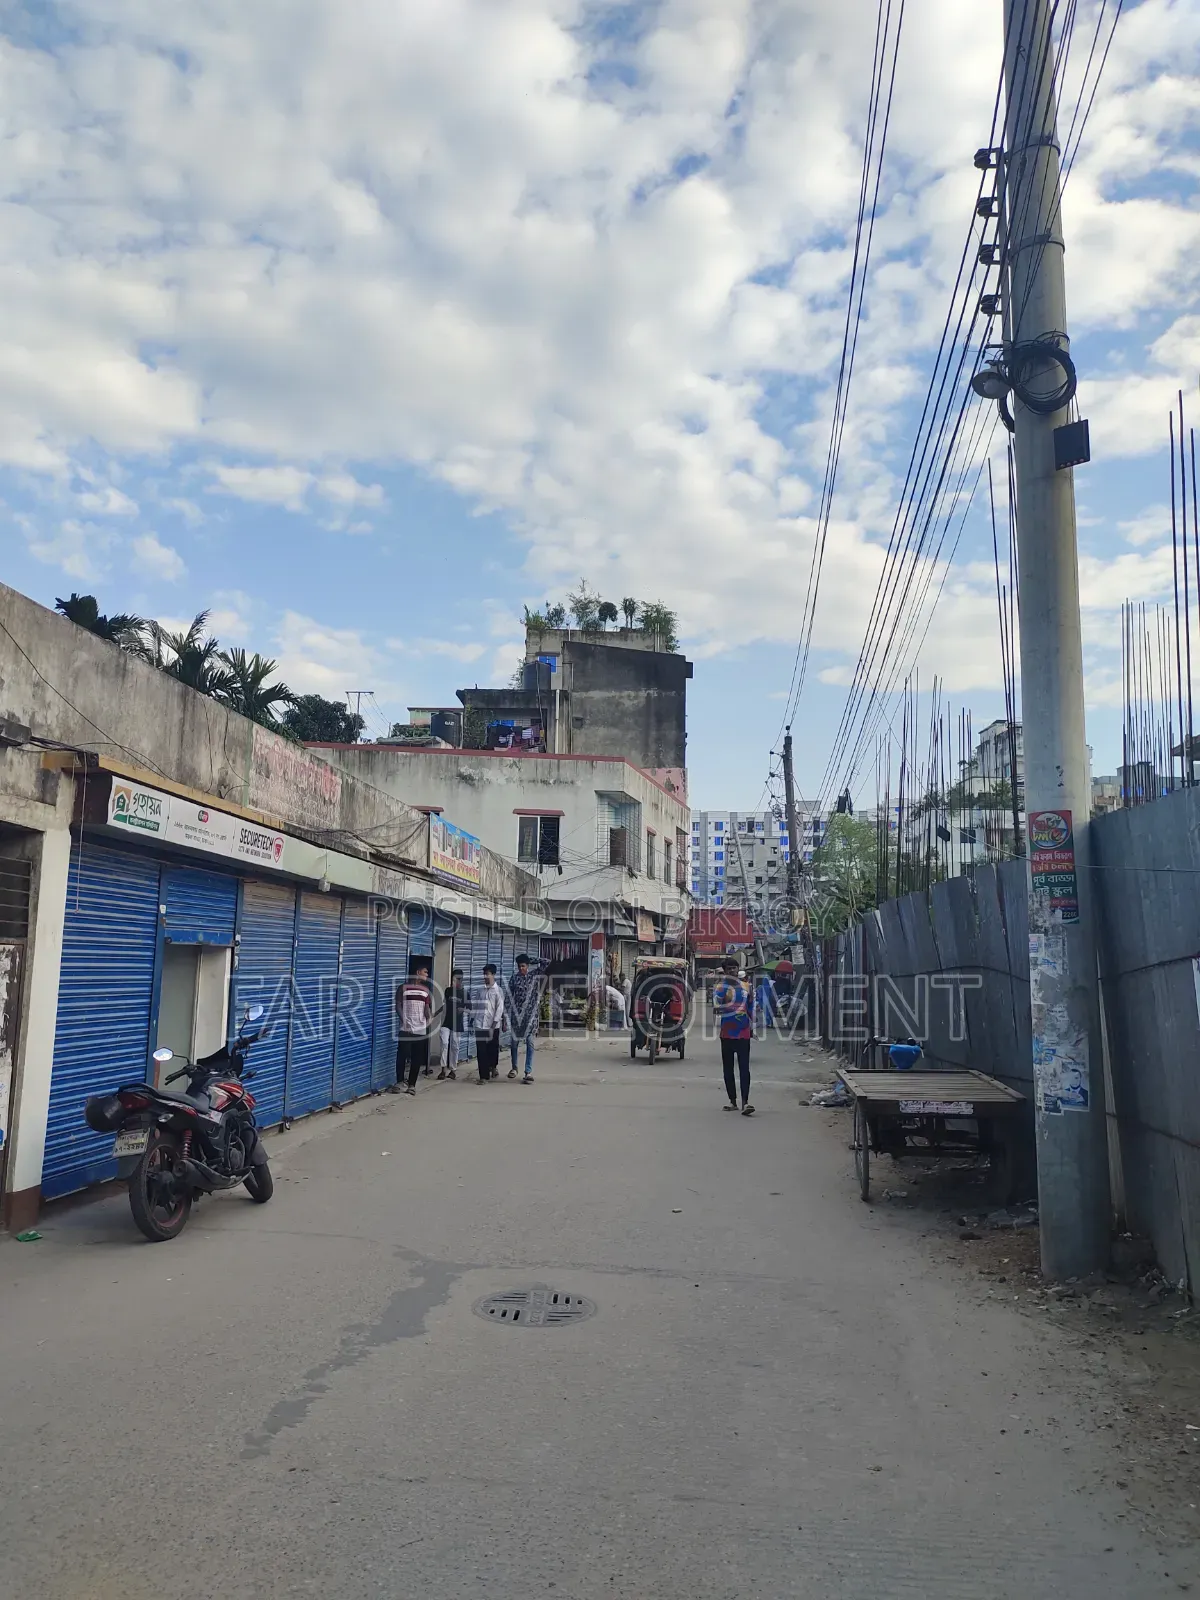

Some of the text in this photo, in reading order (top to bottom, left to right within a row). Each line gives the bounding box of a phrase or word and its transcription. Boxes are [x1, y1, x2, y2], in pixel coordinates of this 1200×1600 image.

[240, 828, 274, 852] SECURETECH
[1033, 874, 1074, 886] পূর্ব বাড্ডা
[1052, 886, 1073, 897] স্কুল
